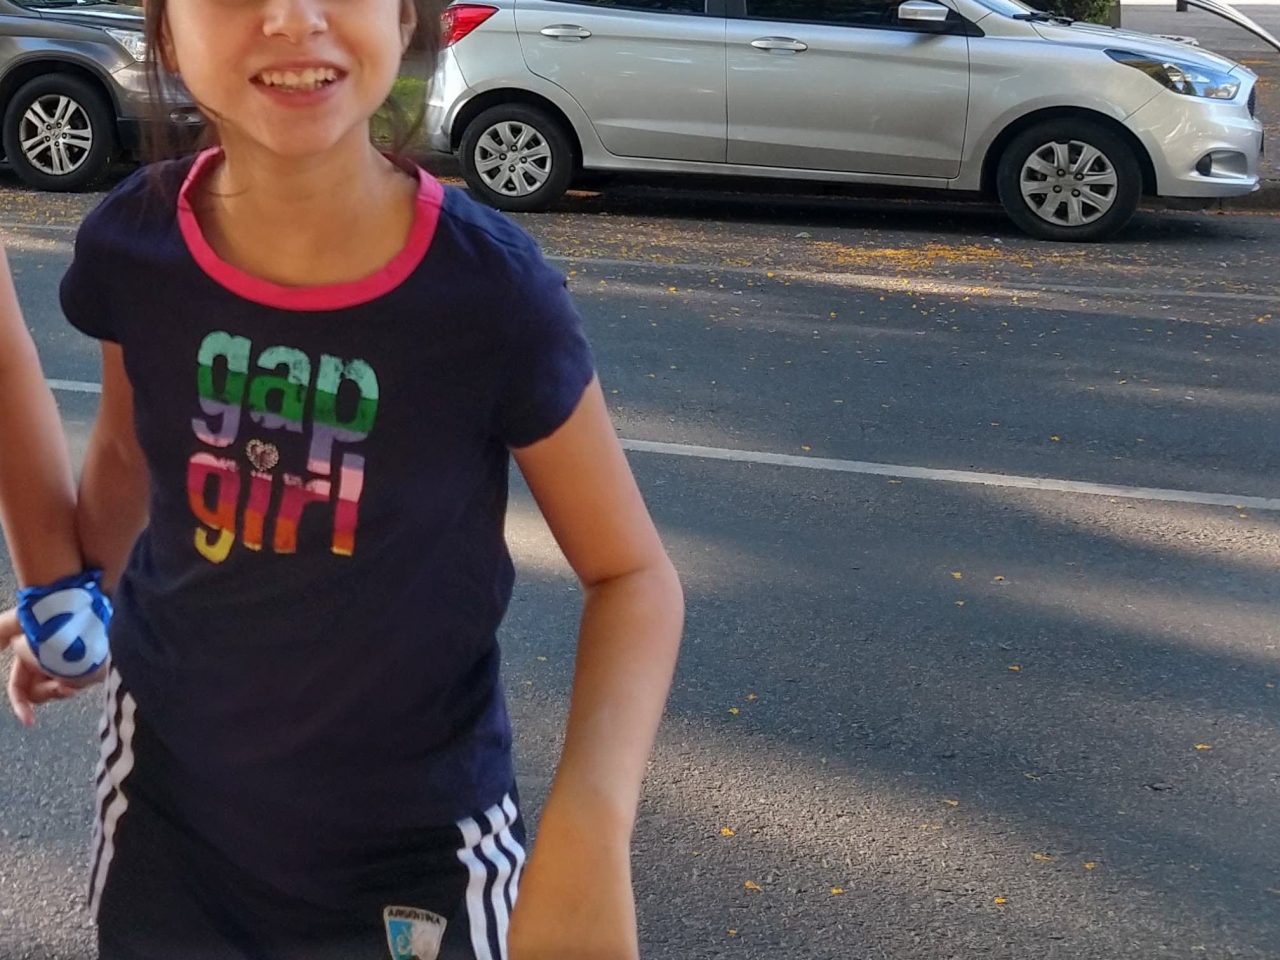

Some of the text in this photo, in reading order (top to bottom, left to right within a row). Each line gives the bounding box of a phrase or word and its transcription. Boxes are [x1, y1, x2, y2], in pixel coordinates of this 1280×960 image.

[191, 330, 380, 475] gap
[187, 451, 365, 564] girl
[387, 908, 440, 925] ARGENTINA
